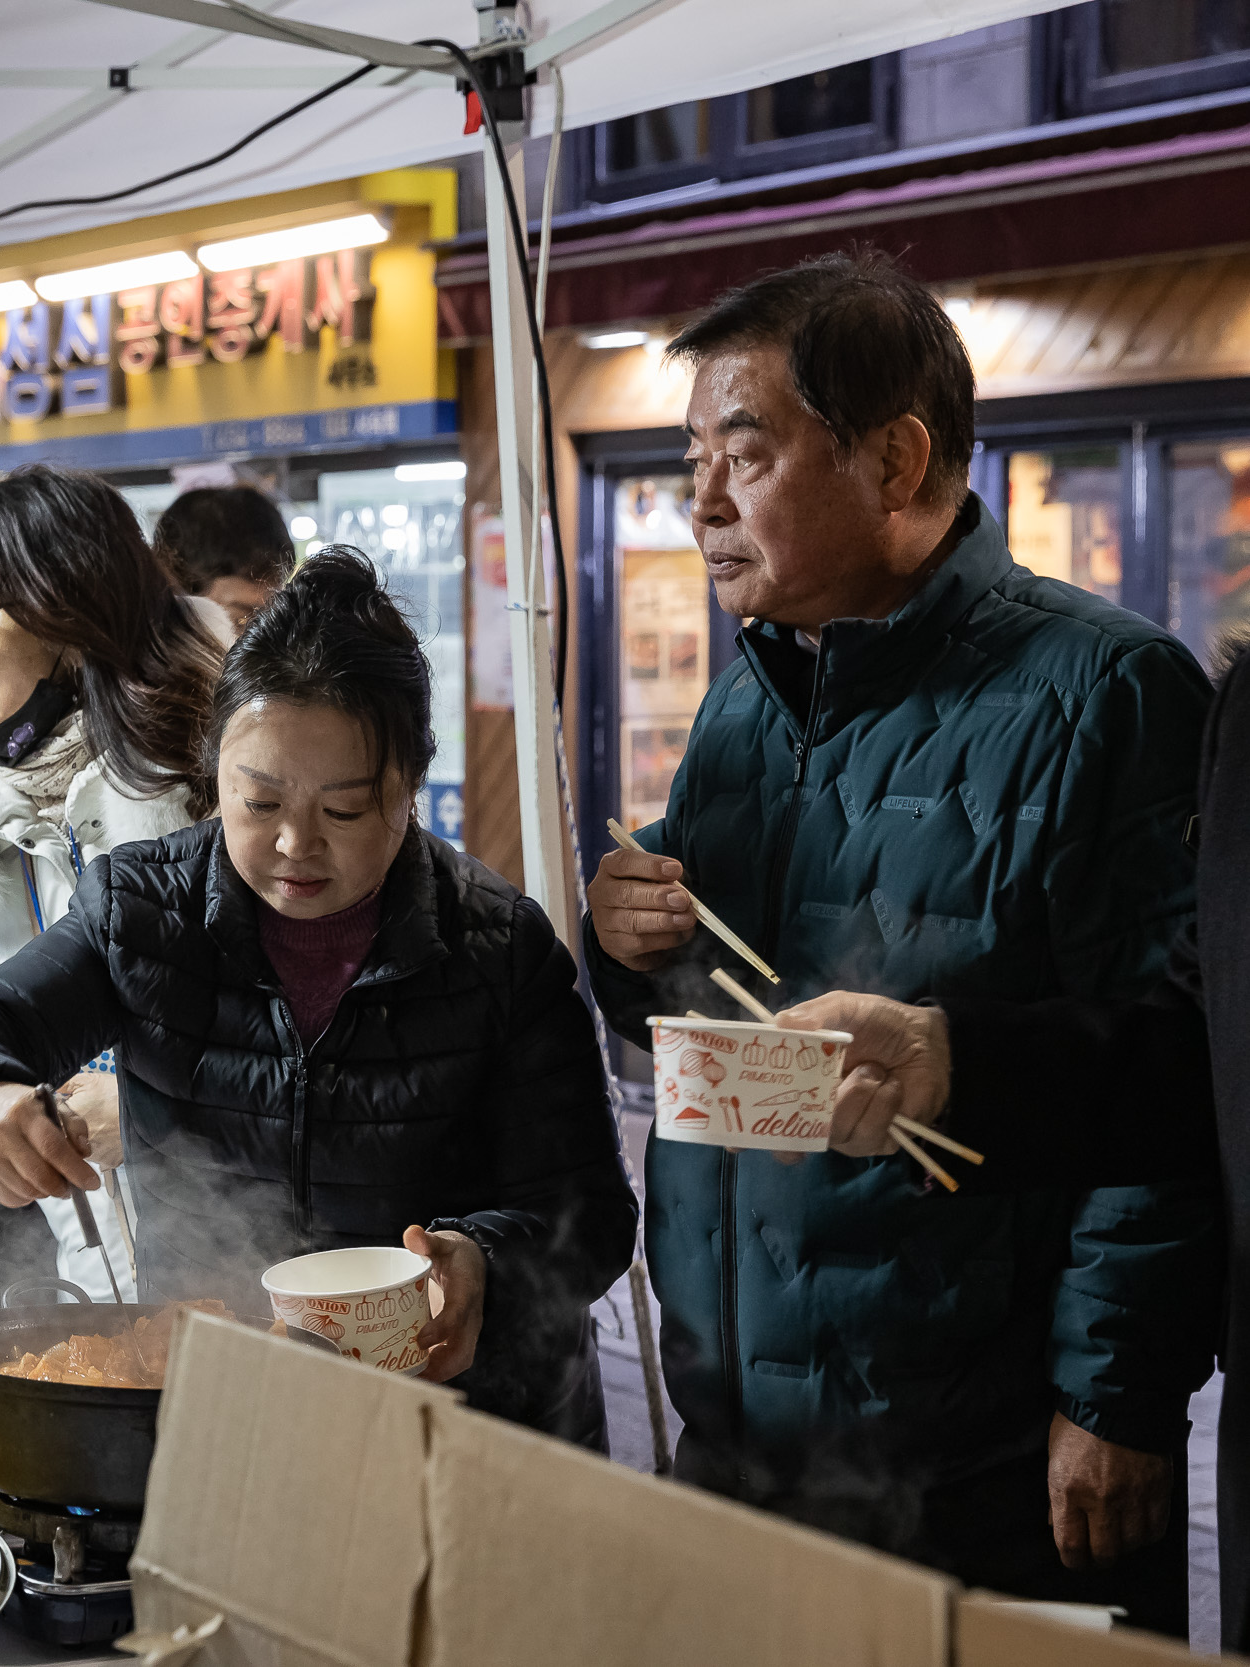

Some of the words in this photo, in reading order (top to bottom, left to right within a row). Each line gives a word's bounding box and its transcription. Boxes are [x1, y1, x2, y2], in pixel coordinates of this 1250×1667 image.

[888, 797, 927, 810] LIFELOG
[738, 1069, 795, 1085] PIMENTO
[308, 1299, 348, 1314] ONION
[355, 1318, 400, 1335] PIMENTO
